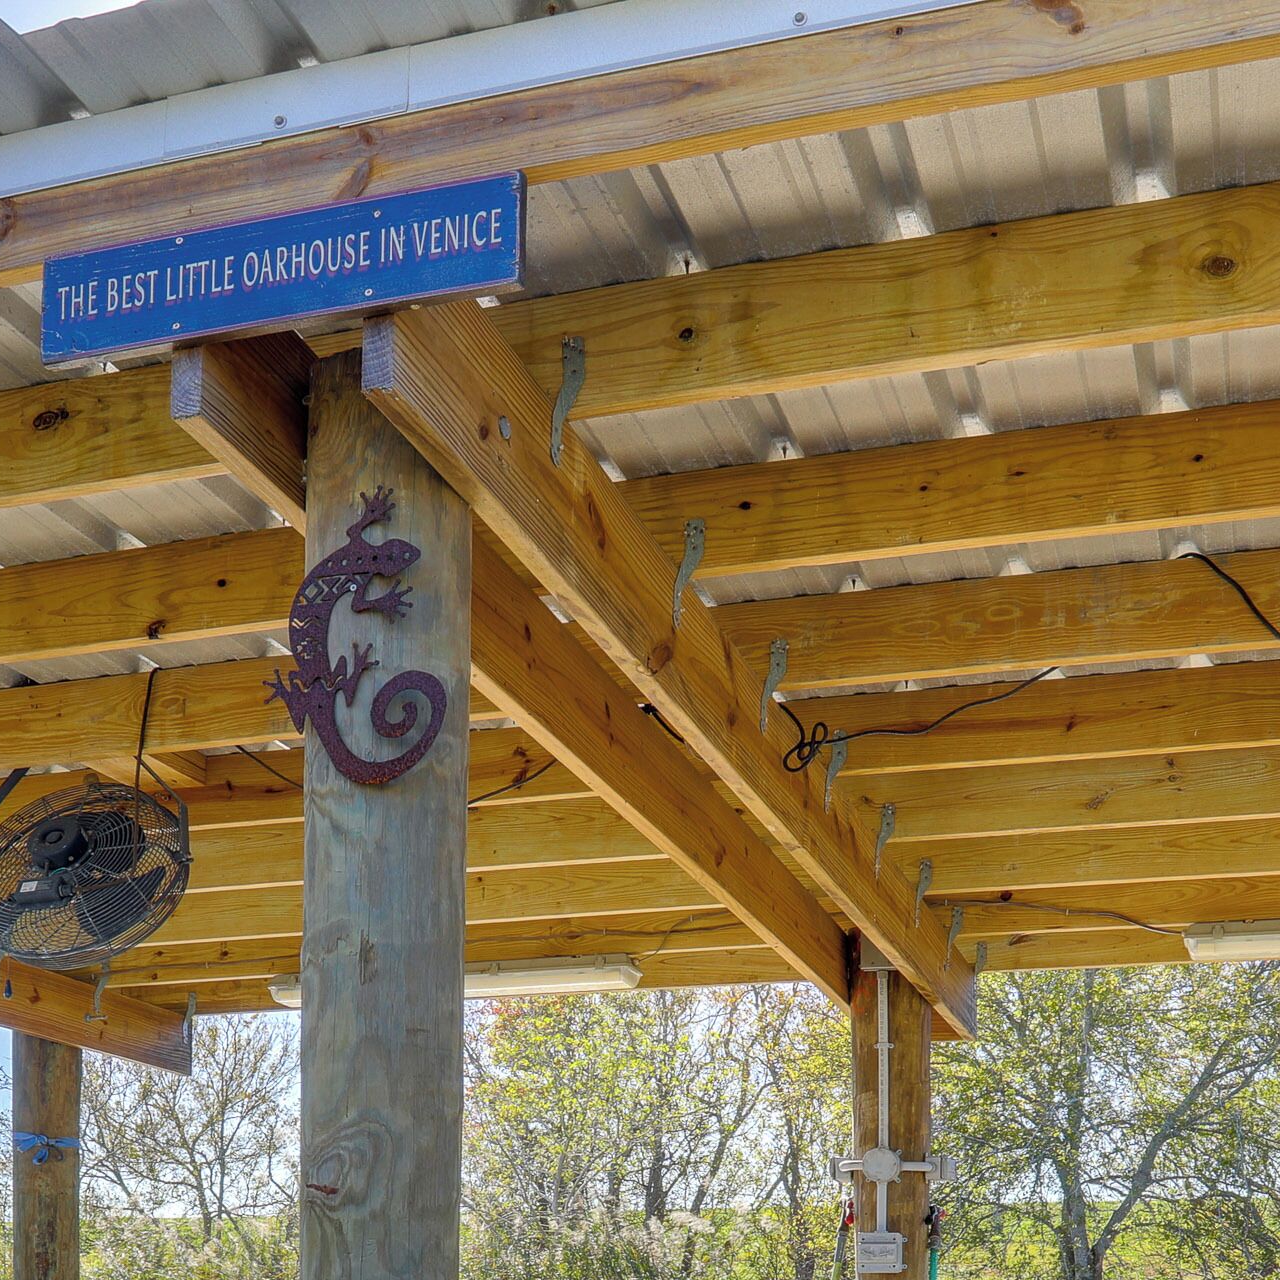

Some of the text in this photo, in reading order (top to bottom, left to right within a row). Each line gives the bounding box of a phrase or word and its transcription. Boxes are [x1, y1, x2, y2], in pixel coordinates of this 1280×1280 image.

[58, 208, 502, 320] THE BEST LITTLE OARHOUSE IN VENICE
